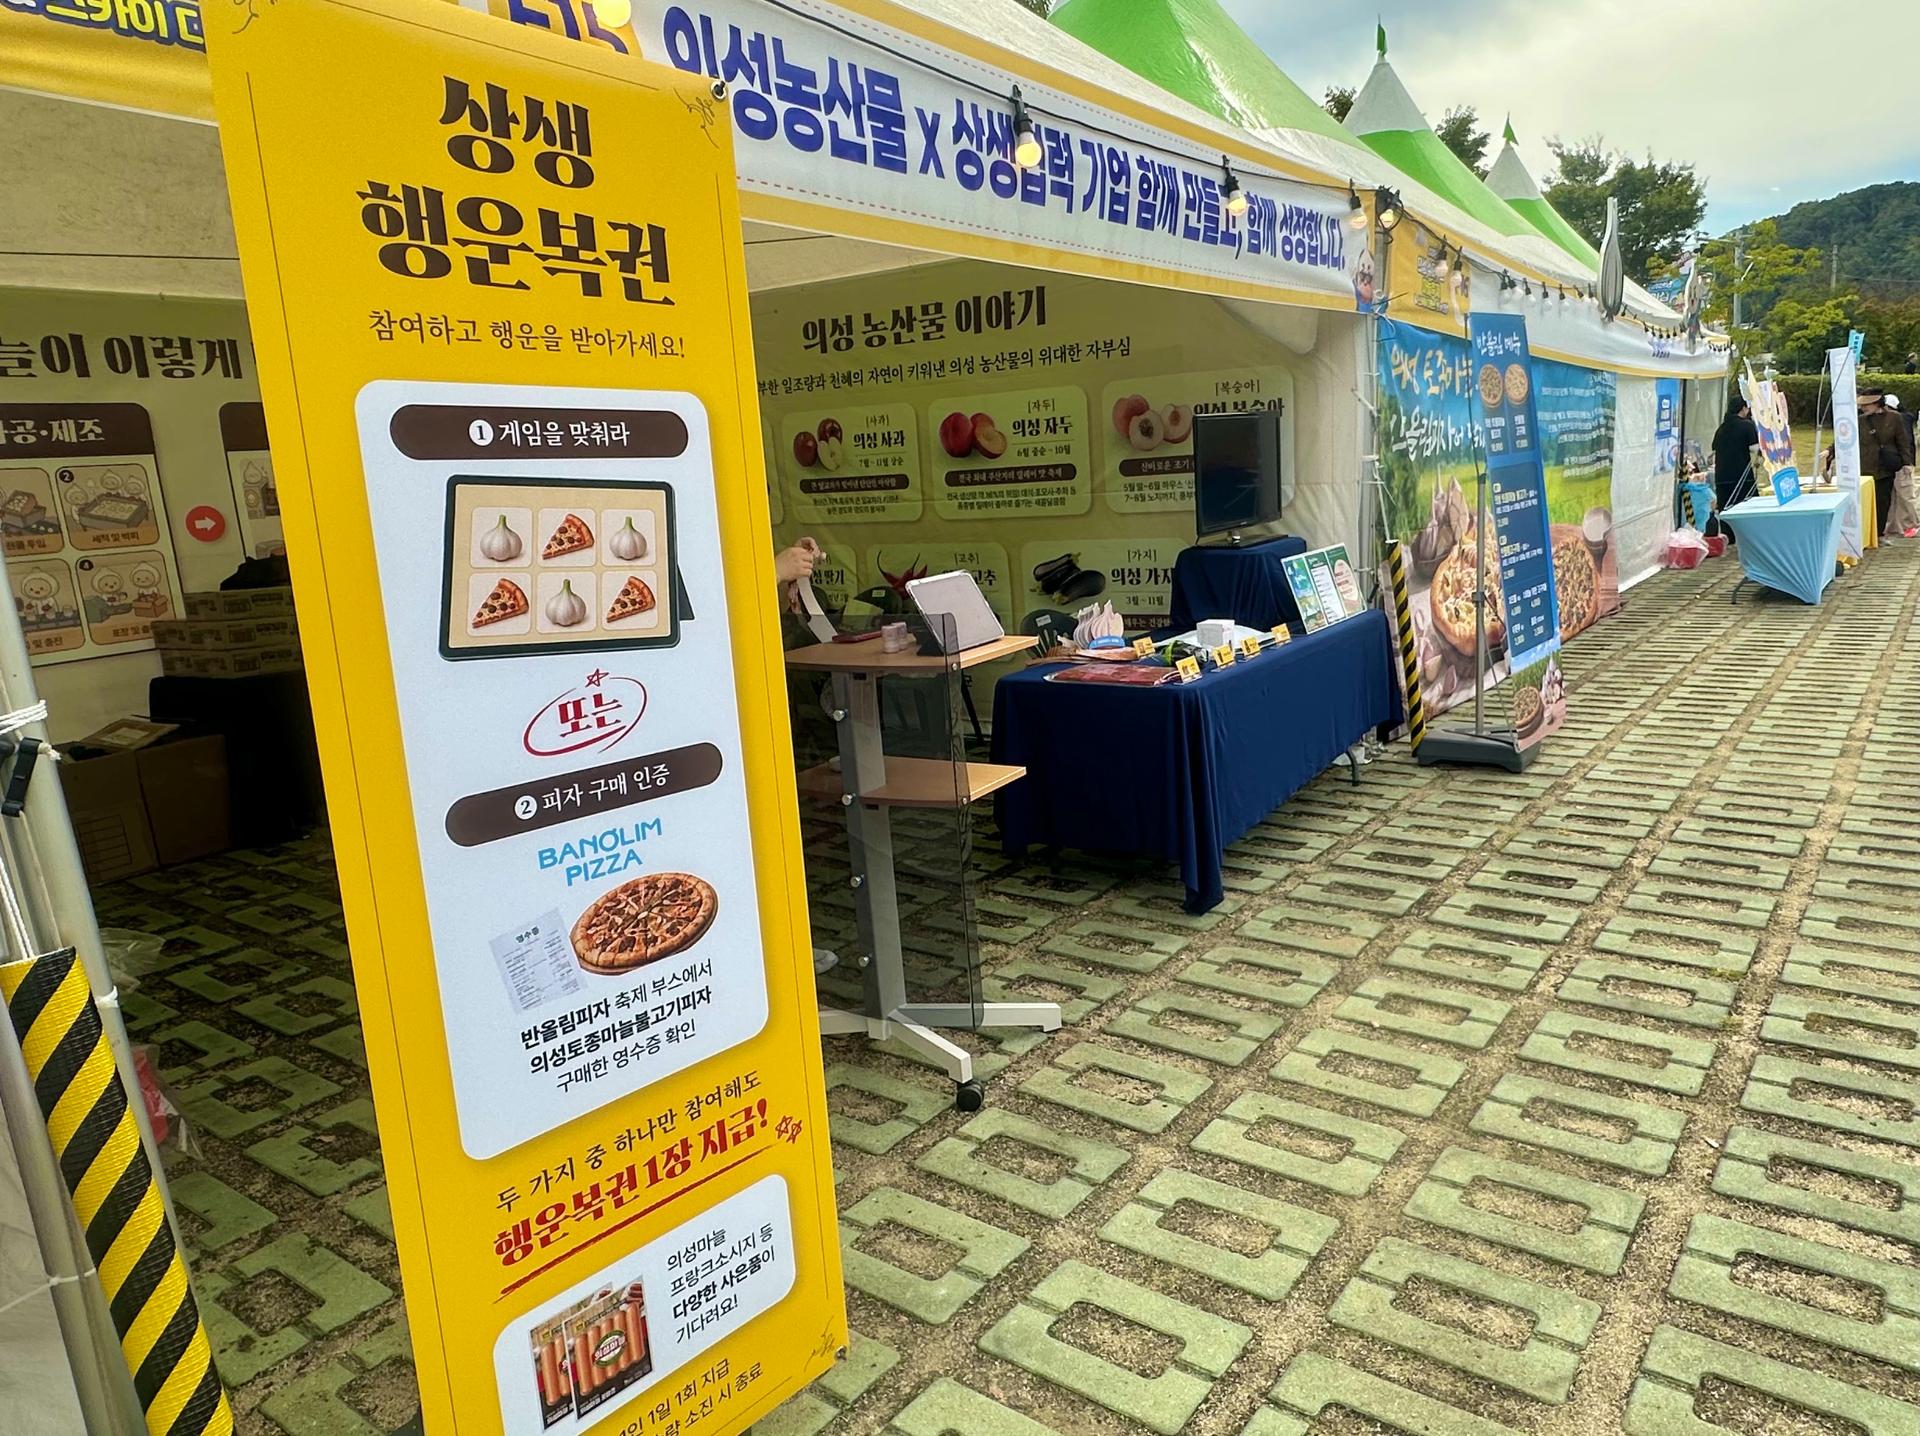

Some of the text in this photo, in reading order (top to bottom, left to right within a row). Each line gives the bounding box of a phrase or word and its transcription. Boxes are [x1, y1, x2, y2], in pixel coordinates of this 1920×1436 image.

[439, 75, 594, 189] 상생
[663, 5, 907, 175] 의성농산물
[1079, 138, 1131, 226] 기업
[1135, 154, 1178, 236] 함께
[1245, 191, 1277, 257] 함께
[1279, 203, 1345, 271] 성장합니다.
[355, 179, 677, 306] 행운복권
[369, 309, 686, 360] 참여하고 행운을 받아가세요!
[802, 285, 1047, 354] 의성 농산물 이야기
[104, 335, 243, 379] 이렇게
[782, 374, 825, 395] 일조량과
[830, 369, 863, 390] 천혜의
[868, 364, 904, 386] 자연이
[907, 359, 947, 381] 키워낸
[949, 355, 975, 377] 의성
[979, 348, 1034, 373] 농산물의
[1038, 342, 1082, 365] 위대한
[1086, 337, 1131, 359] 자부심
[1028, 399, 1056, 413] [자두]
[1215, 379, 1260, 396] [복숭아]
[498, 421, 565, 447] 게임을
[569, 421, 631, 447] 맞춰라
[853, 430, 905, 449] 의성 사과
[865, 415, 890, 428] [사과]
[1012, 416, 1073, 437] 의성 자두
[954, 552, 979, 565] [고추]
[1111, 568, 1141, 586] 의성
[1127, 549, 1157, 563] [가지]
[558, 692, 623, 738] 또는
[542, 784, 583, 812] 피자
[588, 774, 628, 800] 구매
[634, 763, 671, 790] 인증
[538, 817, 663, 869] BANOLIM
[566, 849, 643, 887] PIZZA
[520, 959, 713, 1050] 반올림피자 축제 부스에서
[530, 985, 713, 1074] 의성토종마늘불고기피자
[556, 1018, 696, 1093] 구매한 영수증 확인
[496, 1070, 762, 1213] 두 가지 중 하나만 참여해도
[493, 1098, 769, 1267] 행운복권 1장 지급!
[666, 1226, 727, 1271] 의성마늘
[670, 1222, 774, 1297] 프랑크소시지 등
[672, 1245, 776, 1320] 다양한 사은품이
[676, 1294, 739, 1344] 기다려요!
[647, 1398, 671, 1425] 1일
[674, 1380, 697, 1406] 1회
[701, 1358, 730, 1388] 지급
[653, 1362, 763, 1436] 량 소진 시 종료
